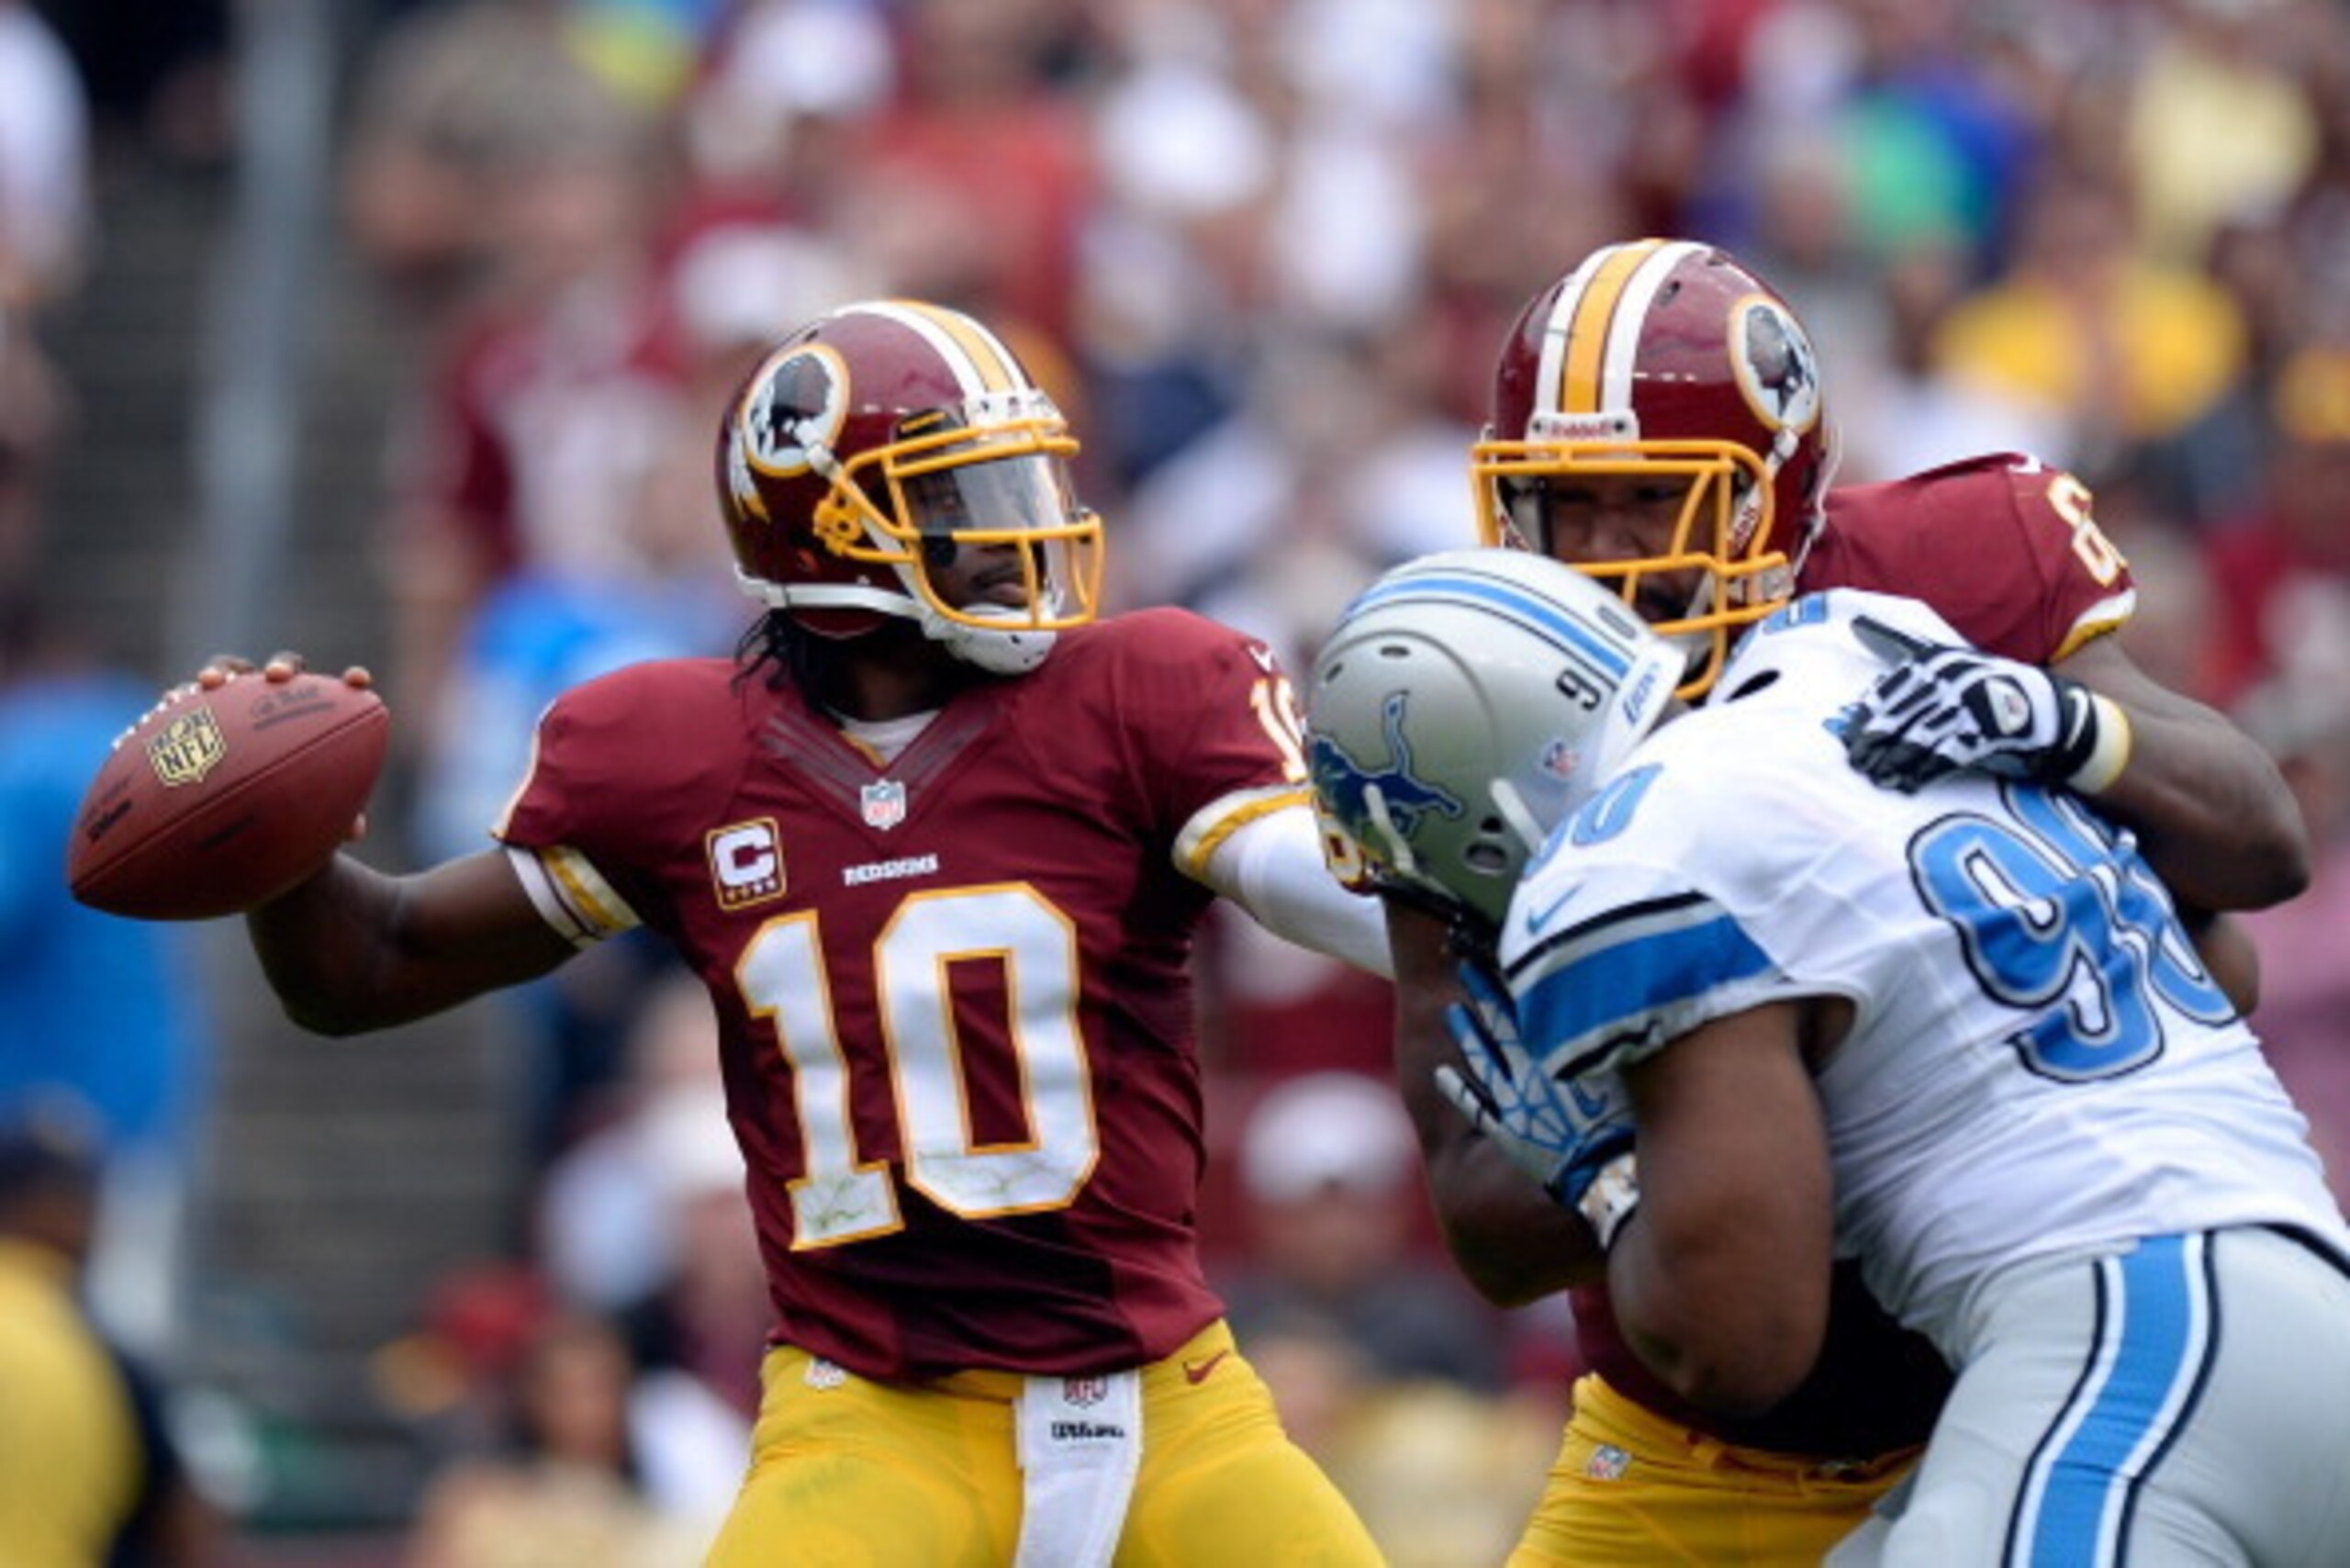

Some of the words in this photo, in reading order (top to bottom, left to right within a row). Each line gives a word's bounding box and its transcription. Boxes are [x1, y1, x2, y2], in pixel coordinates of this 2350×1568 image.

[159, 734, 217, 775] NFL
[712, 825, 777, 888] C
[845, 853, 939, 887] REDSKINS
[733, 880, 1101, 1251] 10
